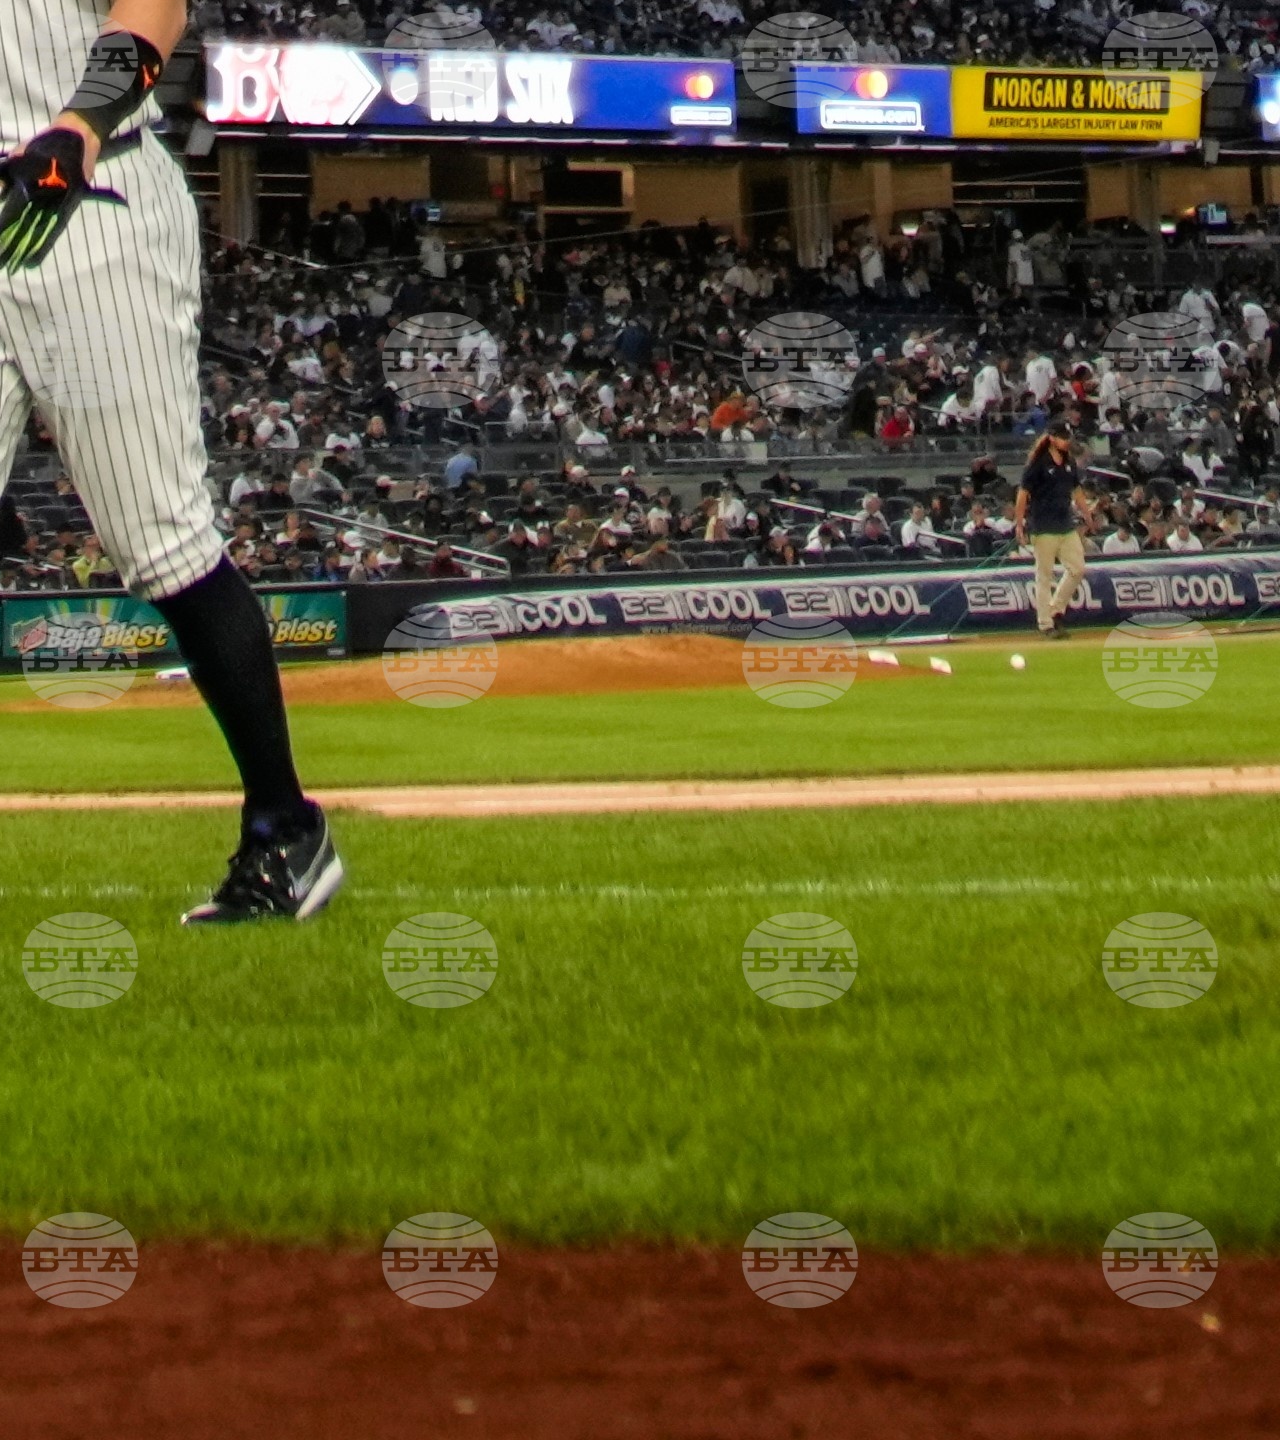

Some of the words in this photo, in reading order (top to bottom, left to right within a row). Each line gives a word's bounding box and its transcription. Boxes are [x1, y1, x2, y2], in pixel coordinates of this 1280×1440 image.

[992, 77, 1068, 110] MORGAN
[1072, 79, 1085, 109] &
[1089, 80, 1163, 110] MORGAN
[988, 116, 1040, 129] AMERICA'S
[1041, 117, 1082, 130] LARGEST
[1083, 118, 1118, 130] INJURY
[1119, 119, 1138, 131] LAW
[1140, 119, 1164, 131] FIRM
[687, 586, 773, 620] COOL
[849, 584, 931, 617] COOL
[1171, 573, 1246, 607] COOL
[516, 592, 608, 631] COOL
[44, 624, 103, 652] Baja
[102, 620, 174, 649] Blast
[272, 618, 338, 643] Blast
